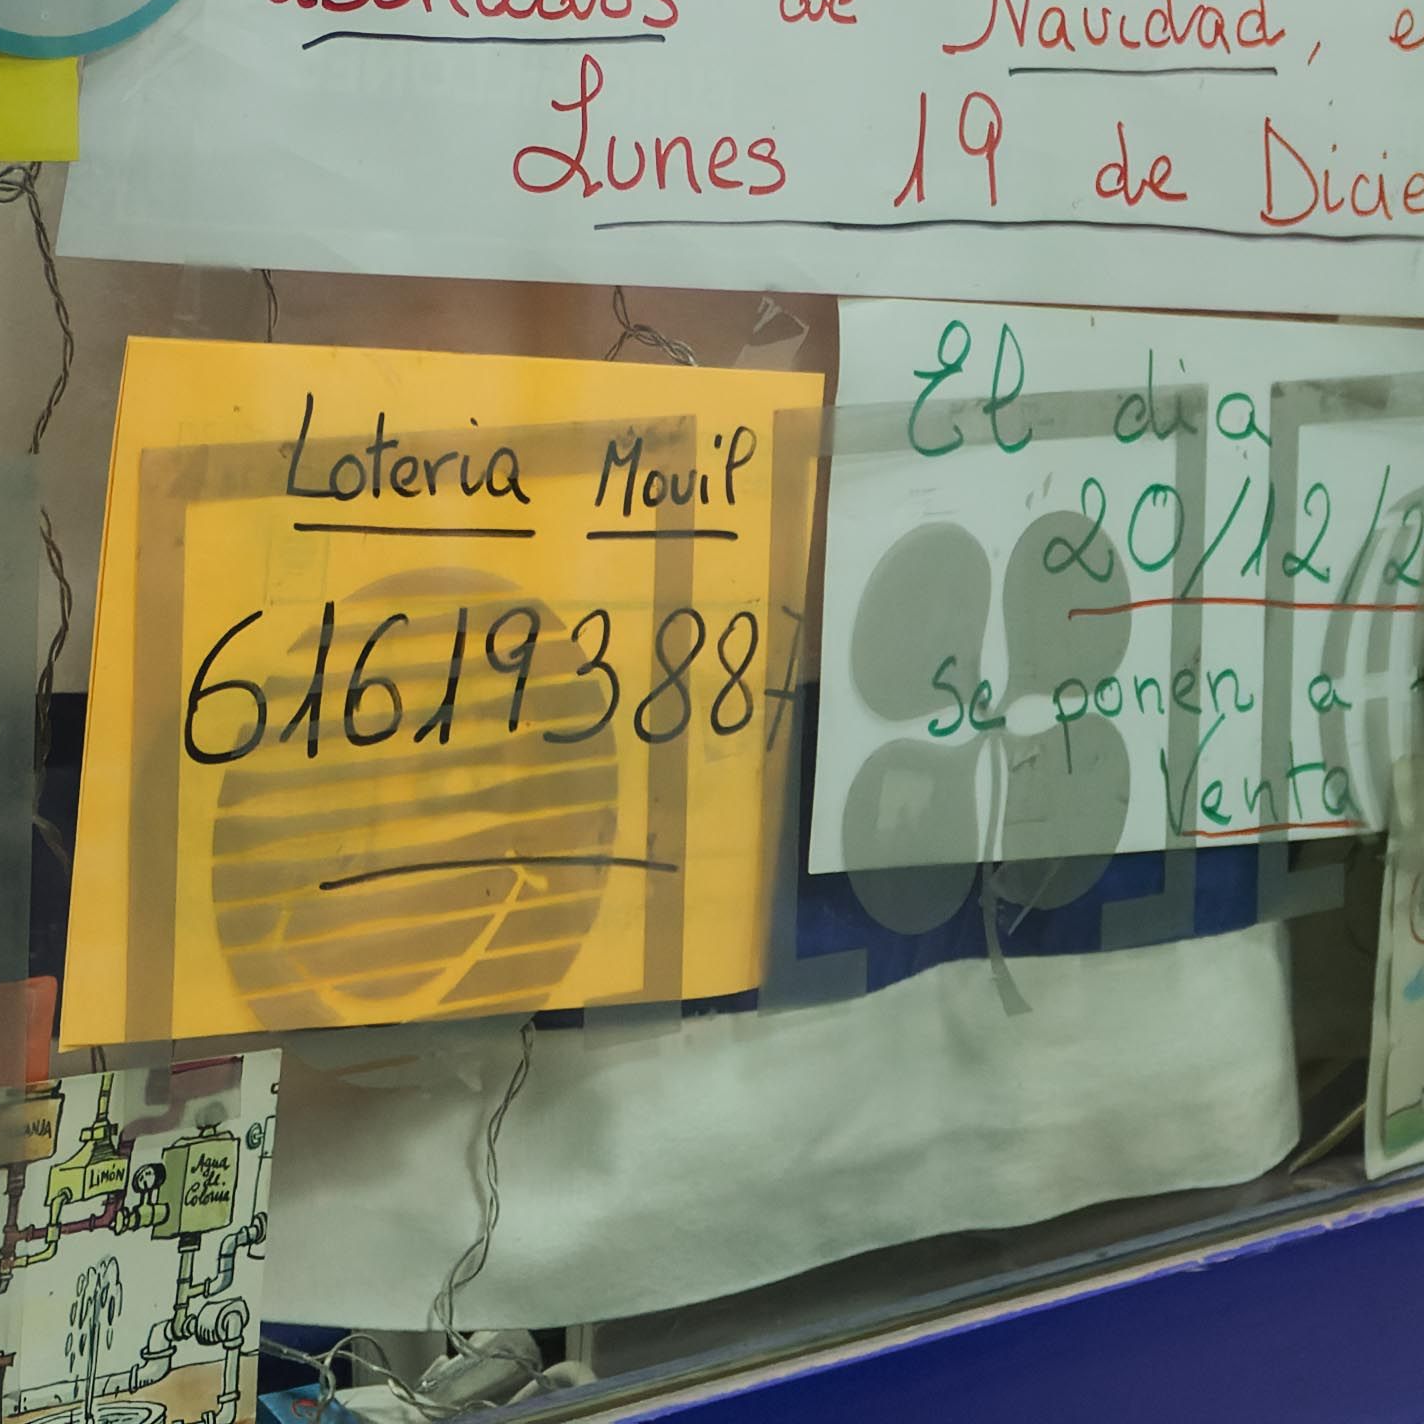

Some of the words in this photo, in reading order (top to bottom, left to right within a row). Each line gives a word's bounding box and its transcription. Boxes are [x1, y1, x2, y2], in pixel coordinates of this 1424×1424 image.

[513, 54, 787, 198] Lunes
[894, 92, 1002, 207] 19
[1095, 121, 1188, 206] de
[285, 391, 533, 506] Loteria
[594, 424, 756, 518] Movil
[908, 319, 1033, 457] El
[1113, 348, 1272, 446] dia
[184, 600, 805, 765] 616193887
[1052, 668, 1254, 775] ponen
[1308, 674, 1353, 716] a
